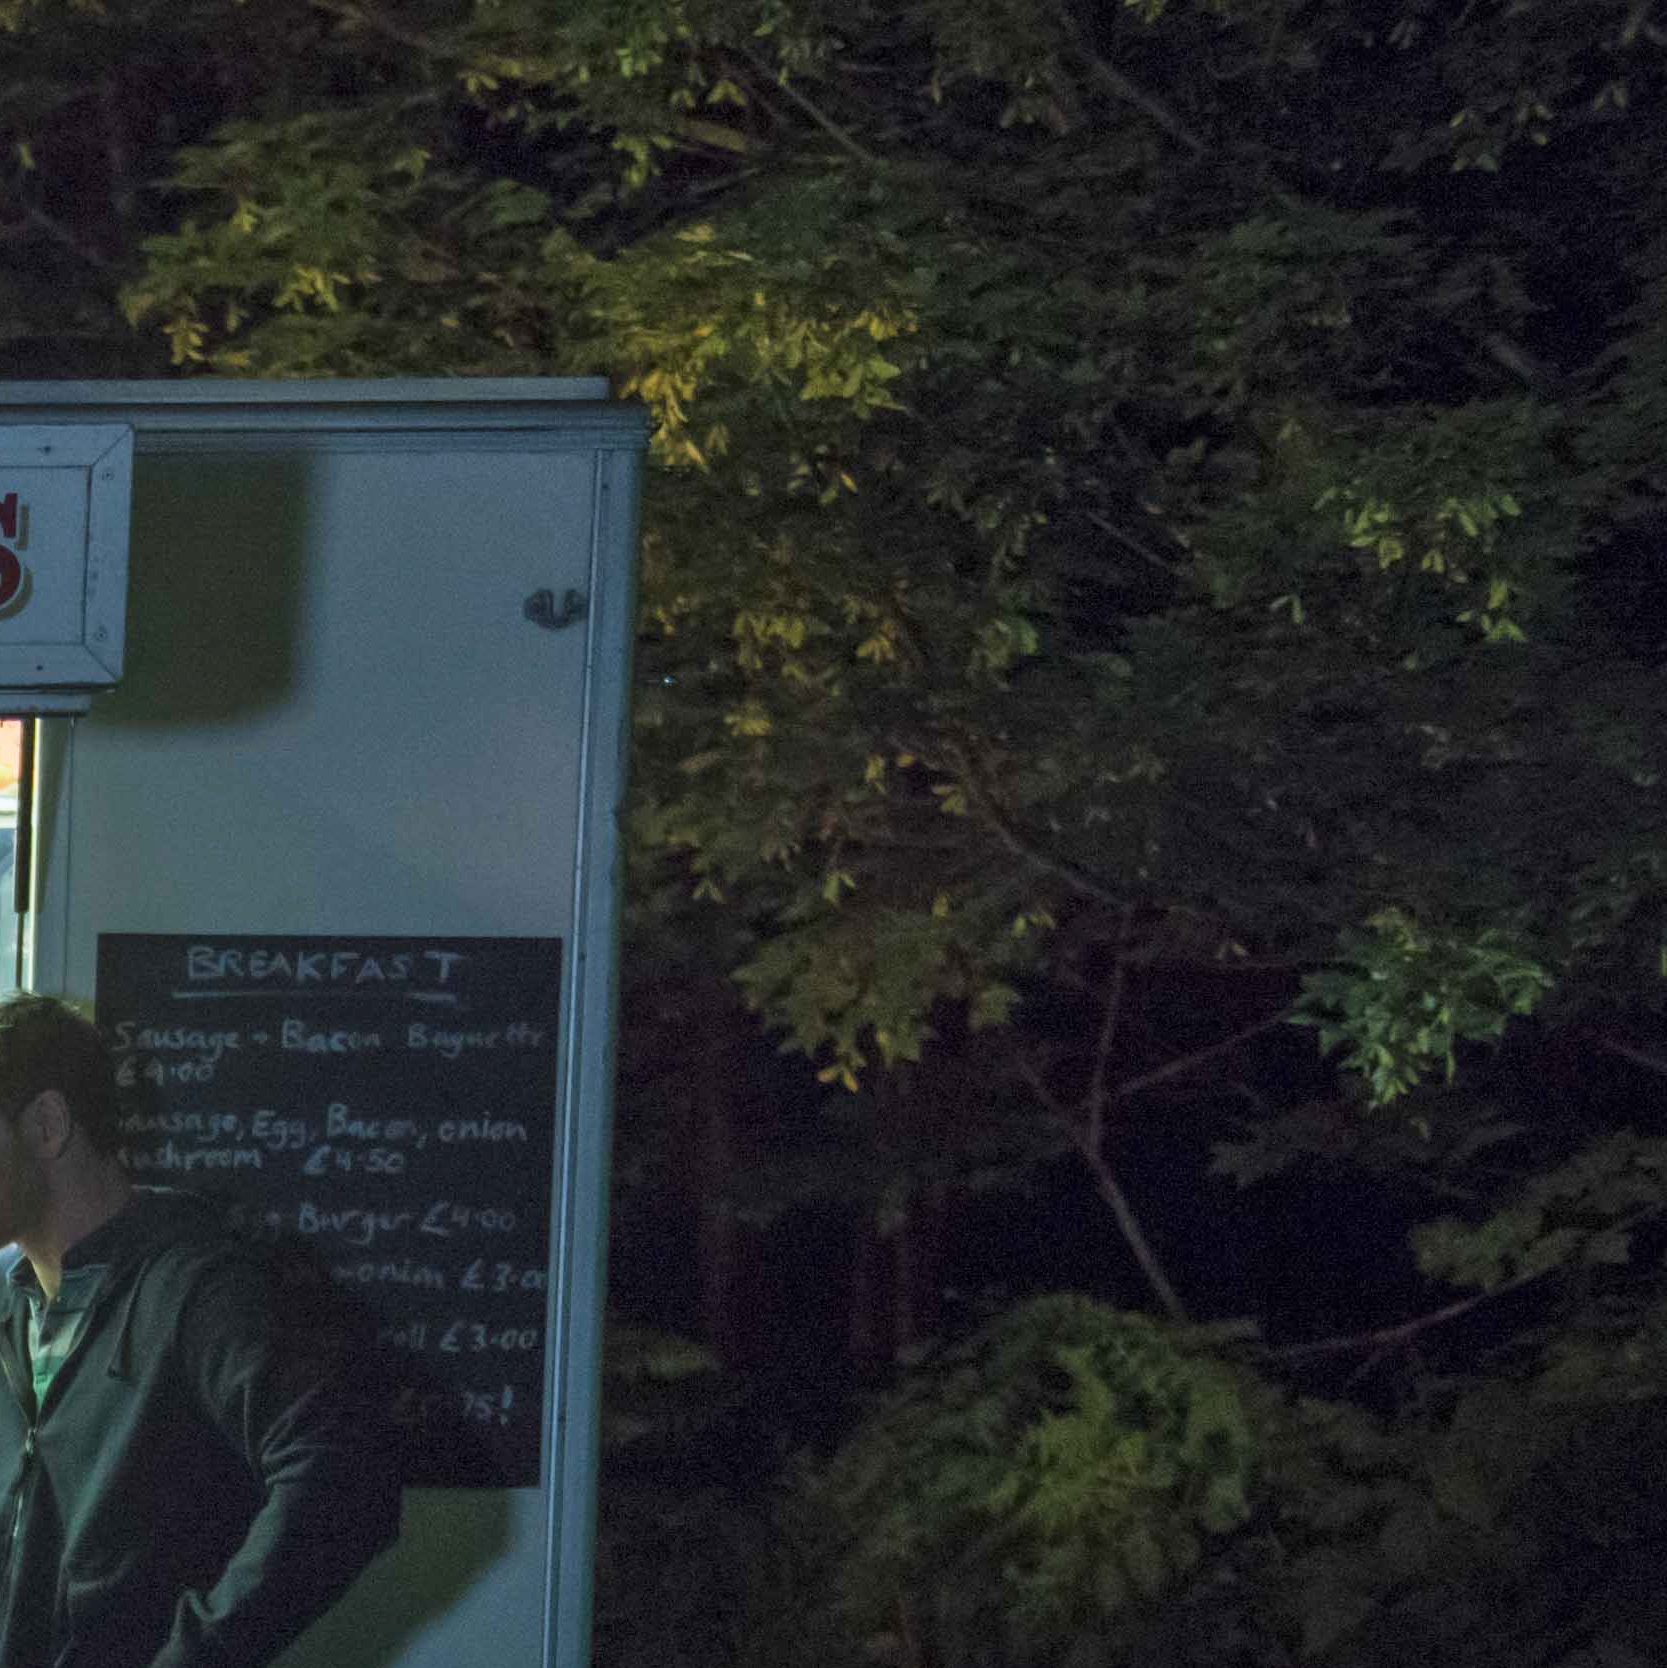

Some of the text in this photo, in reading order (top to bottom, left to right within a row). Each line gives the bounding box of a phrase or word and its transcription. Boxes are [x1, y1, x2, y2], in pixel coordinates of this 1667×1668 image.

[186, 944, 469, 984] BREAKFAST
[112, 1019, 241, 1063] Sausage
[280, 1018, 383, 1053] Bacon
[437, 1110, 529, 1142] onion
[297, 1202, 413, 1246] Burger
